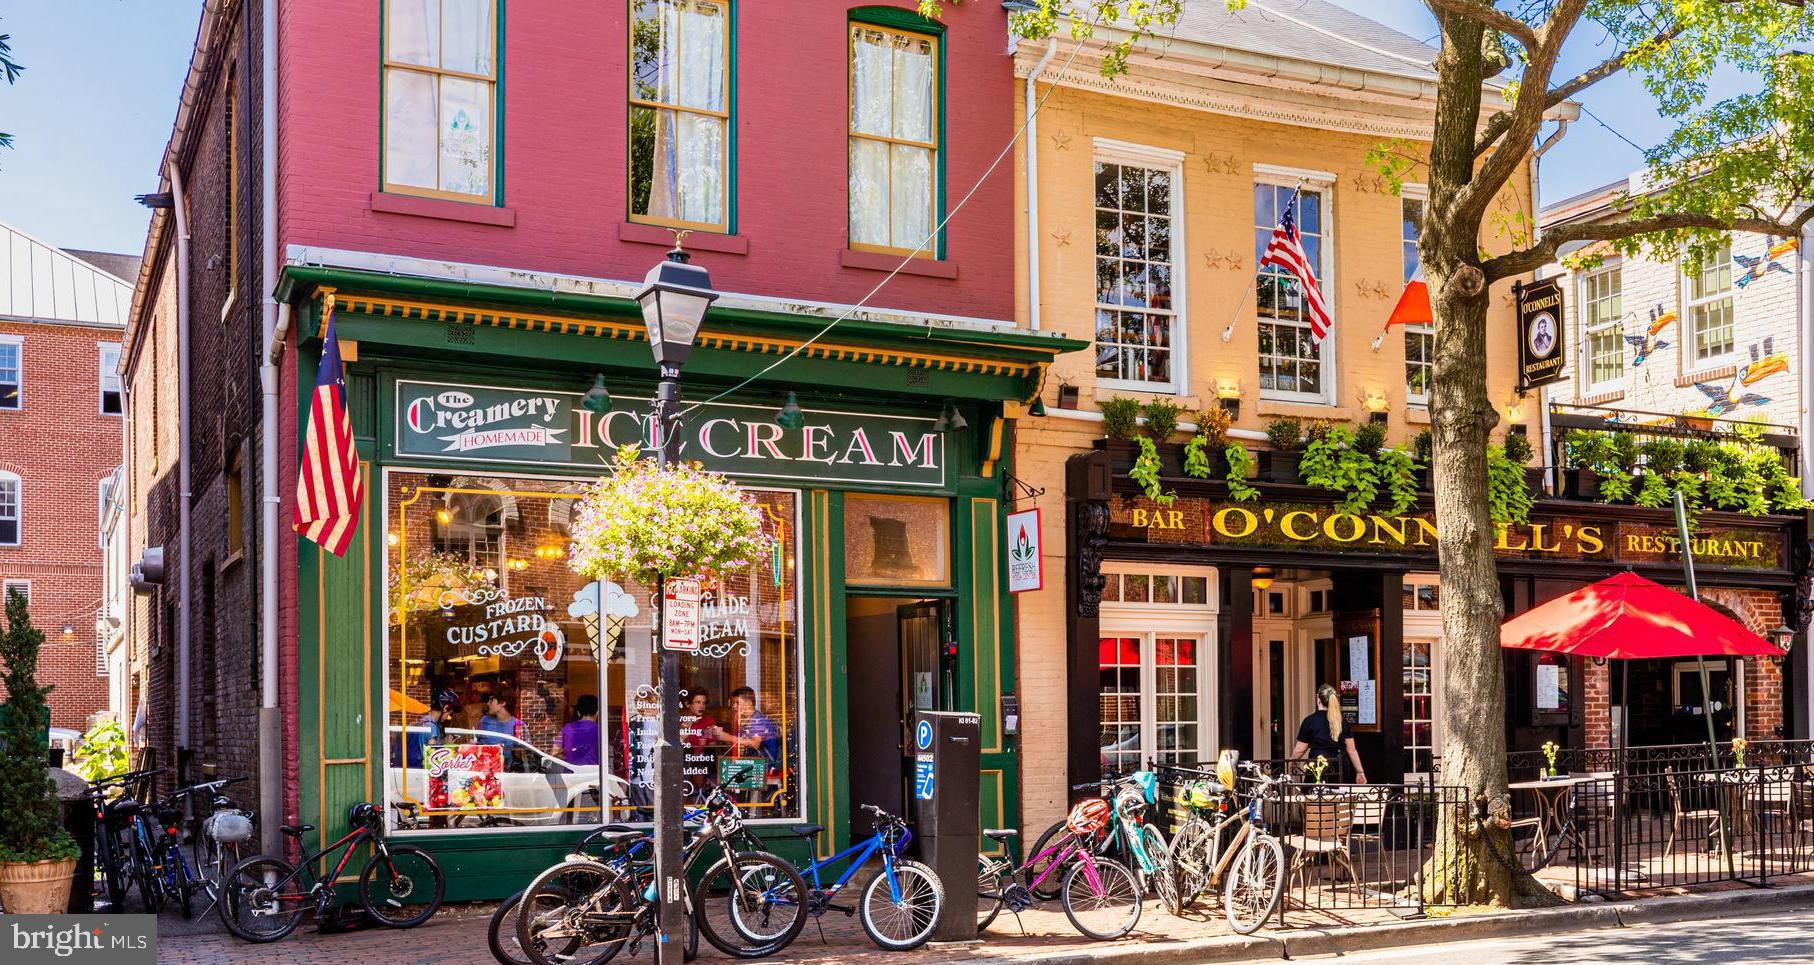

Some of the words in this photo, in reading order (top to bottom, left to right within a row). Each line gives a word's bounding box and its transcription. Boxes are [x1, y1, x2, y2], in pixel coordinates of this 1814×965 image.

[1523, 294, 1560, 314] O'CONNELL'S
[1526, 357, 1561, 373] RESTAURANT
[442, 394, 471, 405] The
[407, 396, 561, 434] Creamery
[463, 431, 543, 448] HOMEMADE
[699, 417, 939, 469] CREAM
[1131, 508, 1186, 531] BAR
[1212, 507, 1604, 554] O'CONNLL'S
[1627, 534, 1763, 559] RESTURANT
[486, 597, 545, 620] FROZEN
[674, 610, 690, 618] ZONE
[446, 614, 546, 645] CUSTARD
[700, 620, 750, 643] REAM
[430, 748, 474, 776] Sorbet
[685, 754, 715, 763] Sorbet
